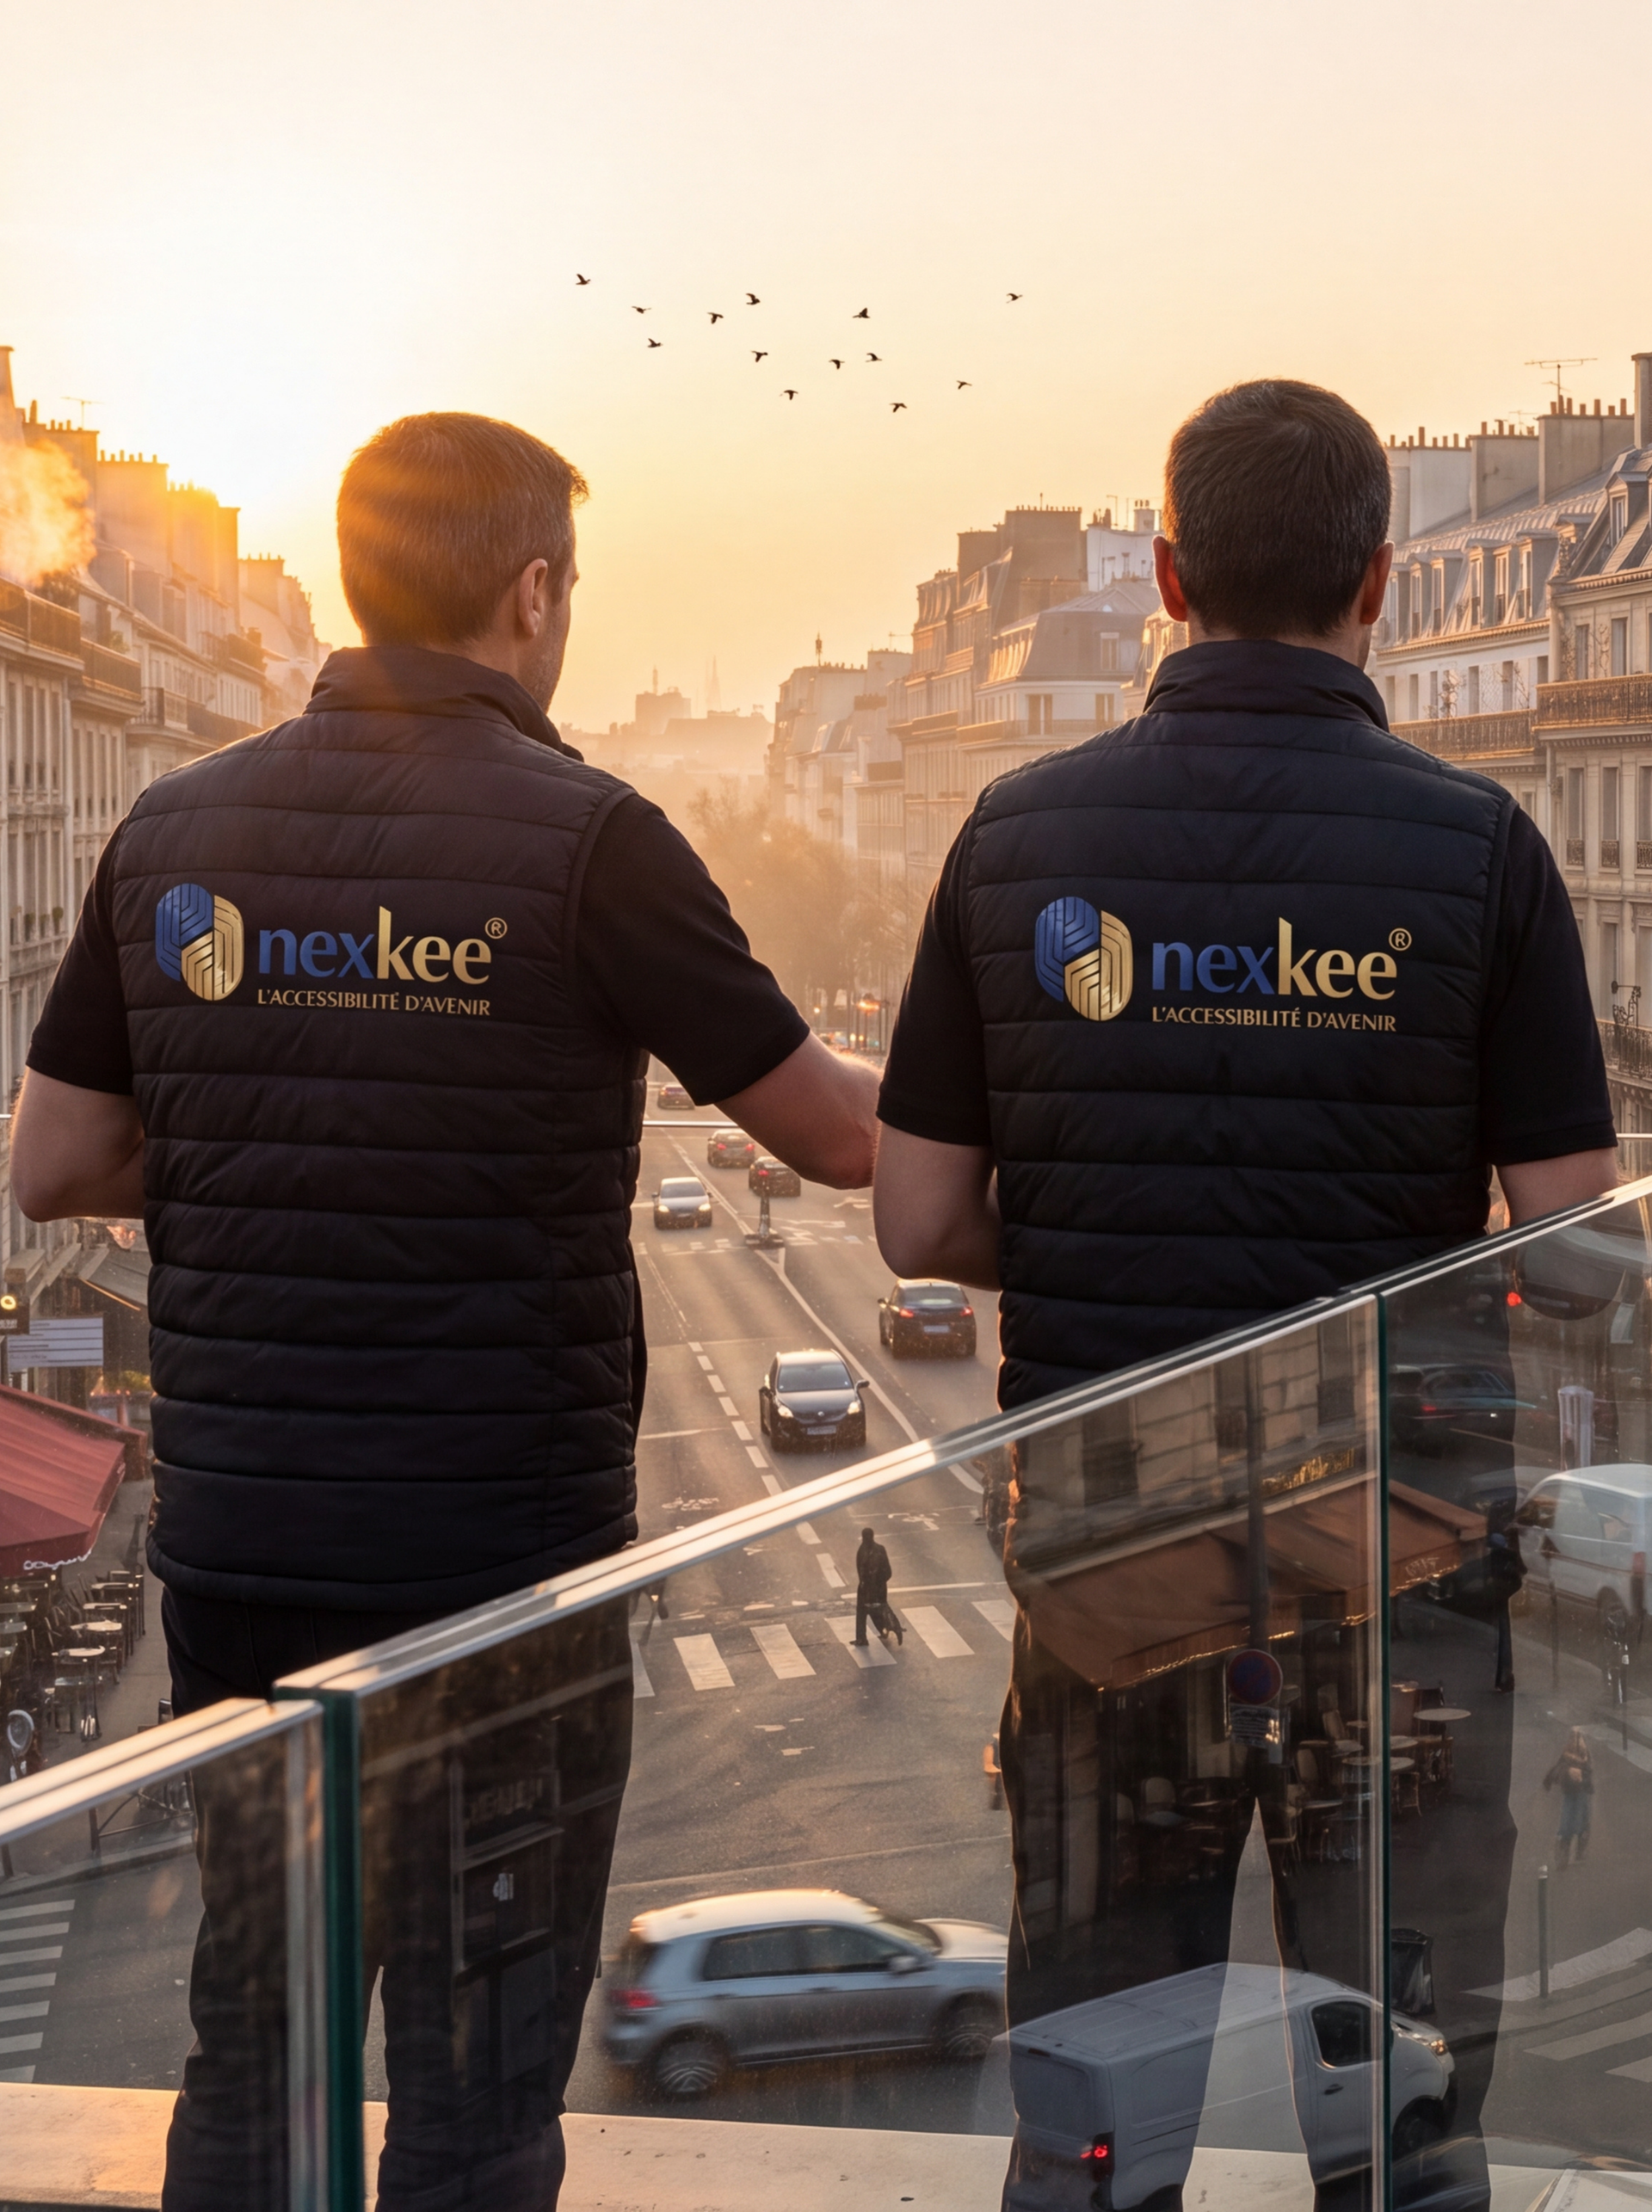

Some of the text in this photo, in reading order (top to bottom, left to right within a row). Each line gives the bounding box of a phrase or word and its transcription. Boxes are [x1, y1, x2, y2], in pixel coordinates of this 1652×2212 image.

[258, 989, 490, 1015] L'ACCESSIBILITÉ D'AVENIR
[1152, 1006, 1396, 1032] L'ACCESSIBILITÉ D'AVENIR
